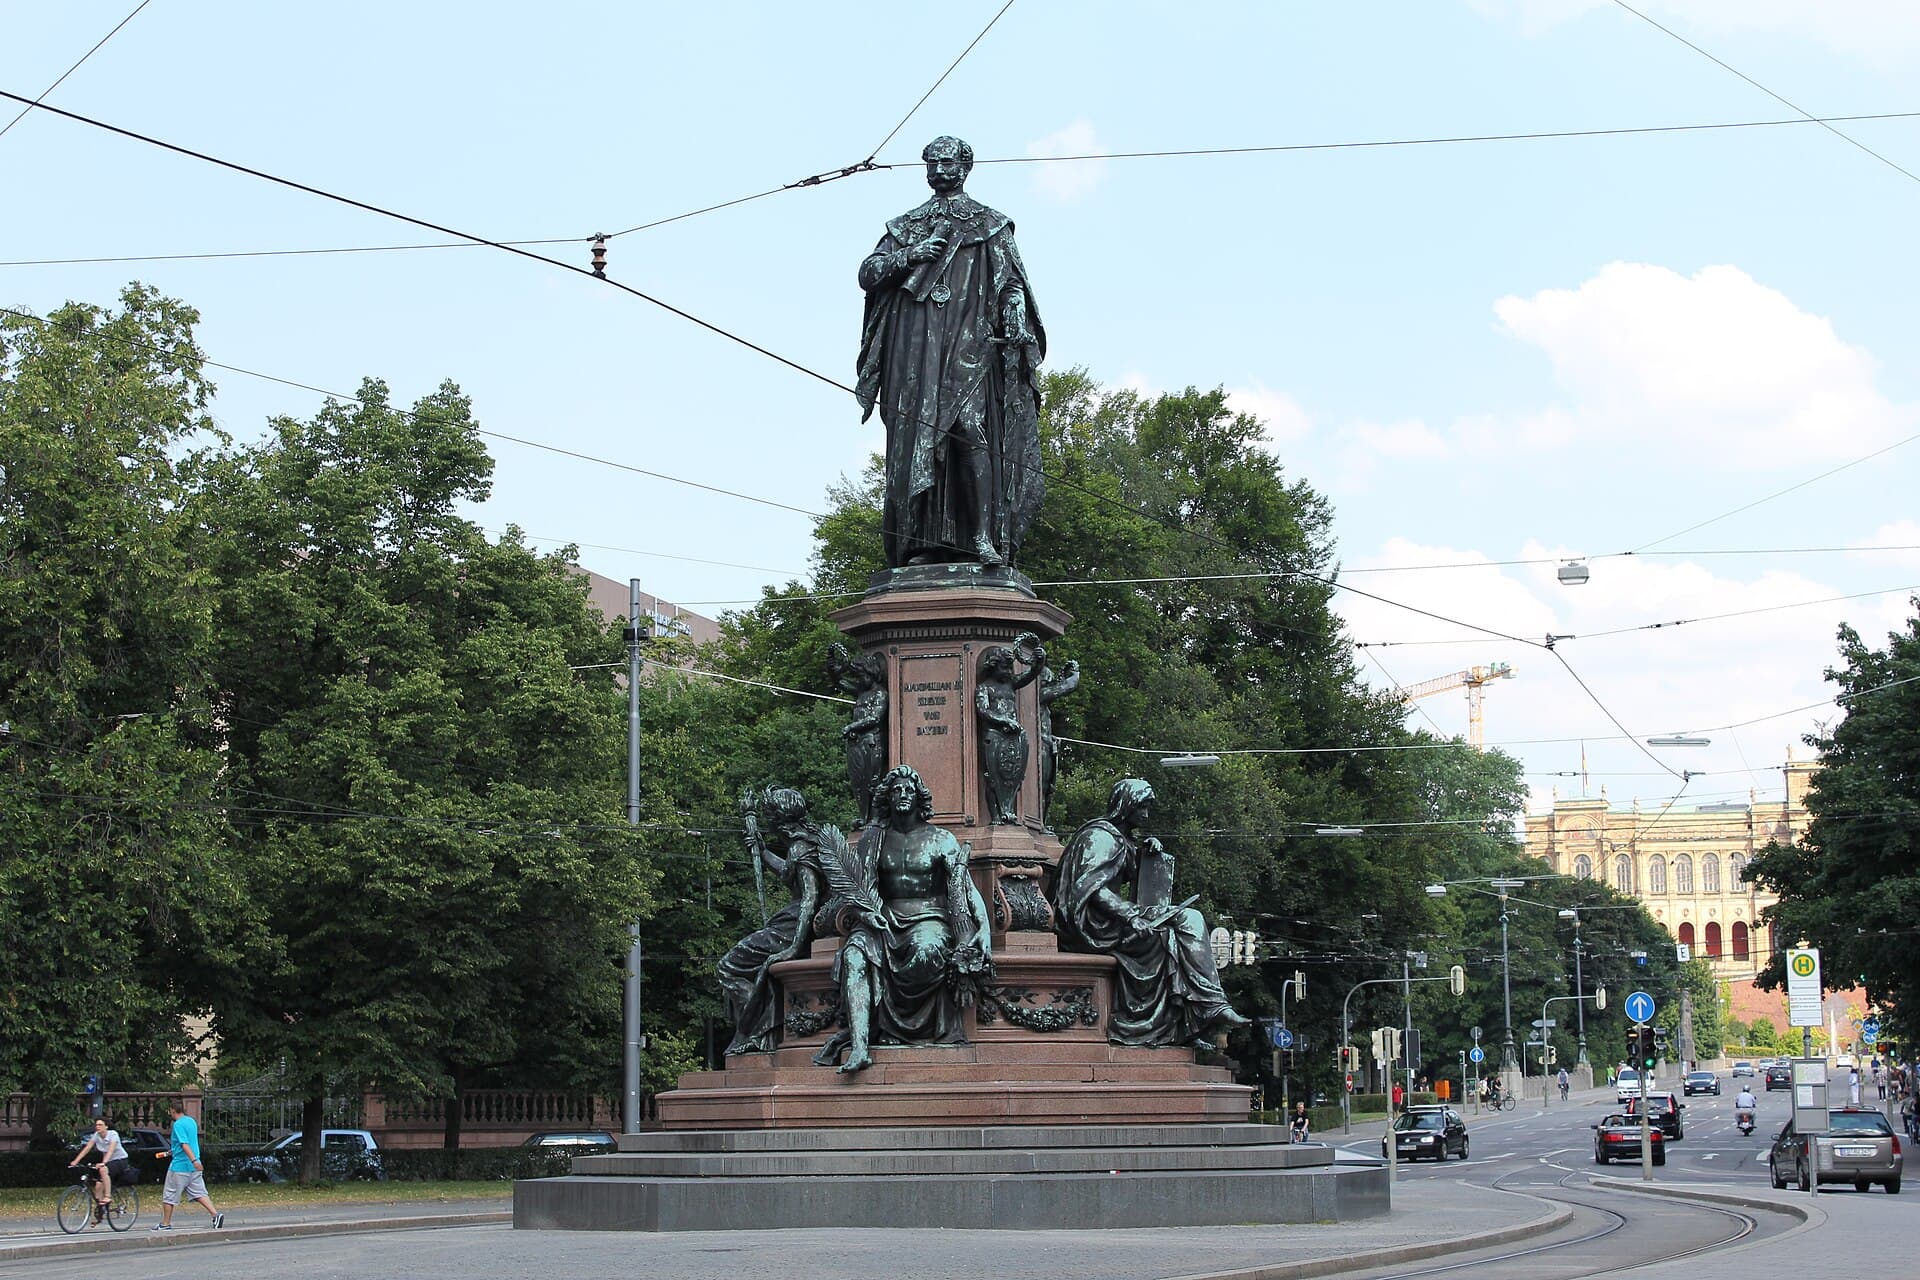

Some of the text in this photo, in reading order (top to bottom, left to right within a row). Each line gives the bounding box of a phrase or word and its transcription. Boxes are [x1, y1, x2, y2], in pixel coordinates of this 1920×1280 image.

[923, 711, 940, 720] VON
[916, 726, 948, 736] BAYERN
[1798, 959, 1809, 972] H
